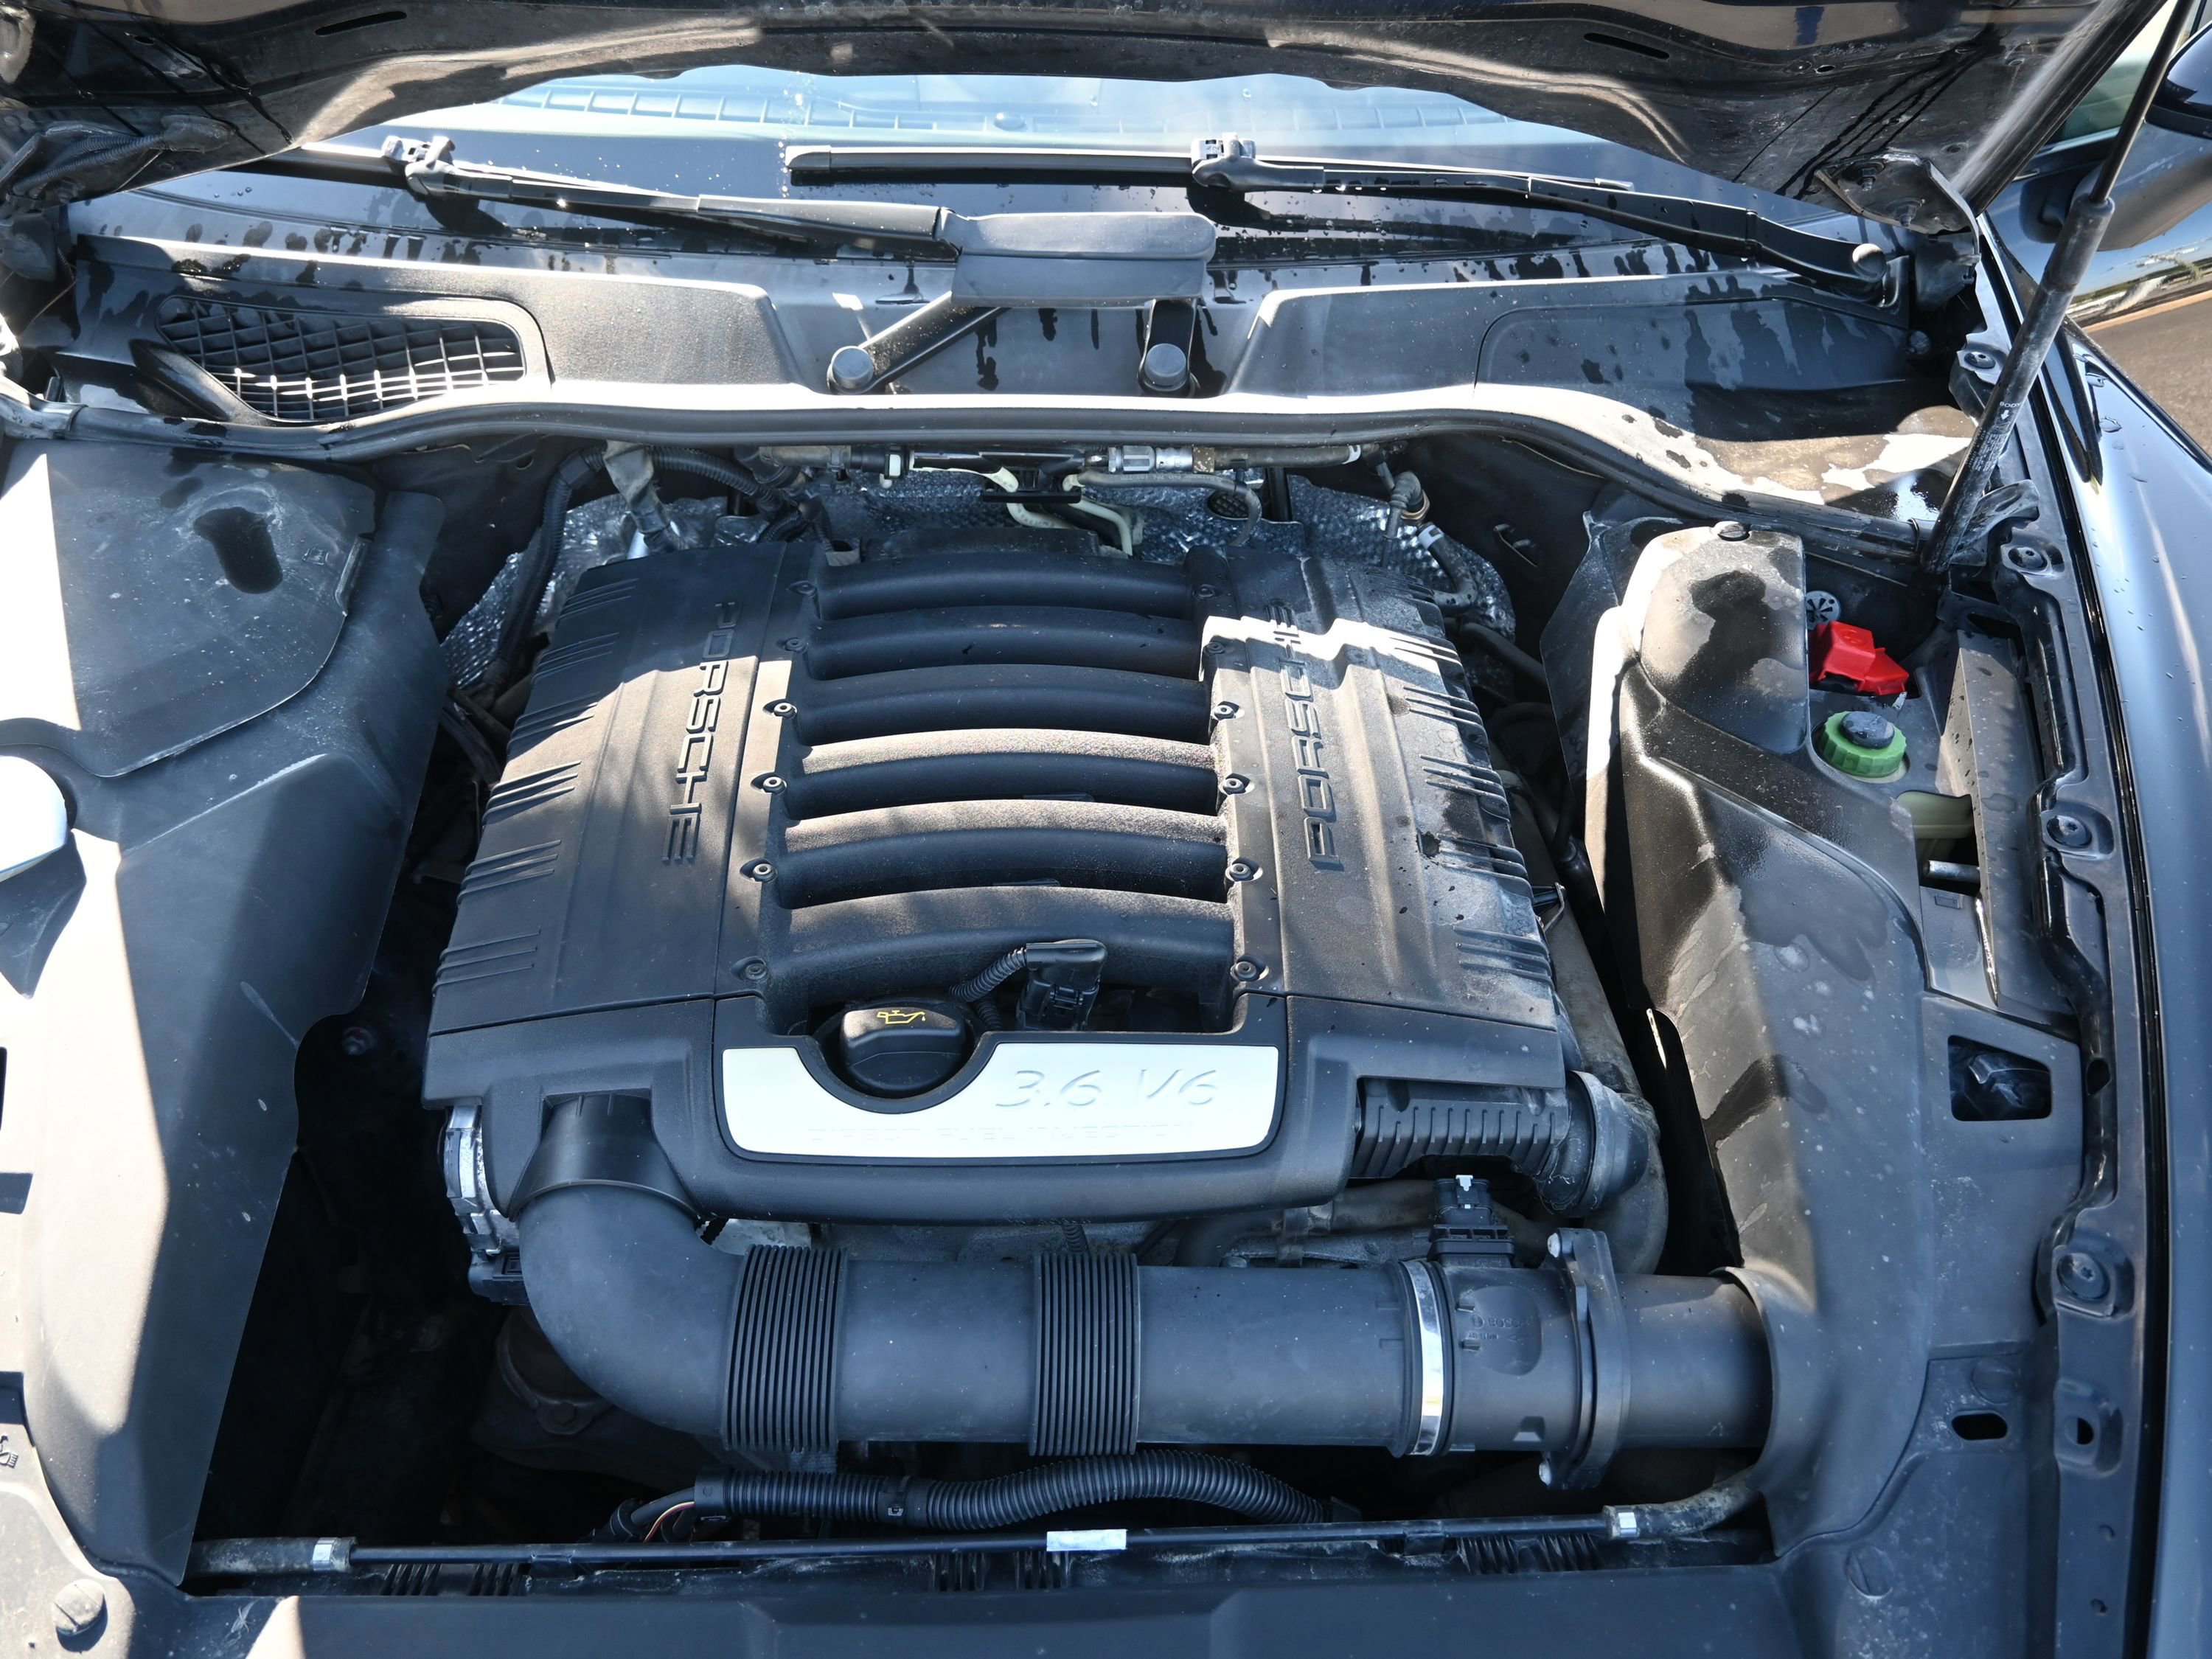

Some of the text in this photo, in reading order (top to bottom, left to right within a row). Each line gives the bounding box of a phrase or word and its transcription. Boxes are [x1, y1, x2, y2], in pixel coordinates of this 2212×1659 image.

[1999, 400, 2021, 408] BODY
[661, 601, 742, 866] PORSCHE
[1267, 605, 1344, 870] PORSCHE
[995, 1068, 1219, 1107] 3.6 V6
